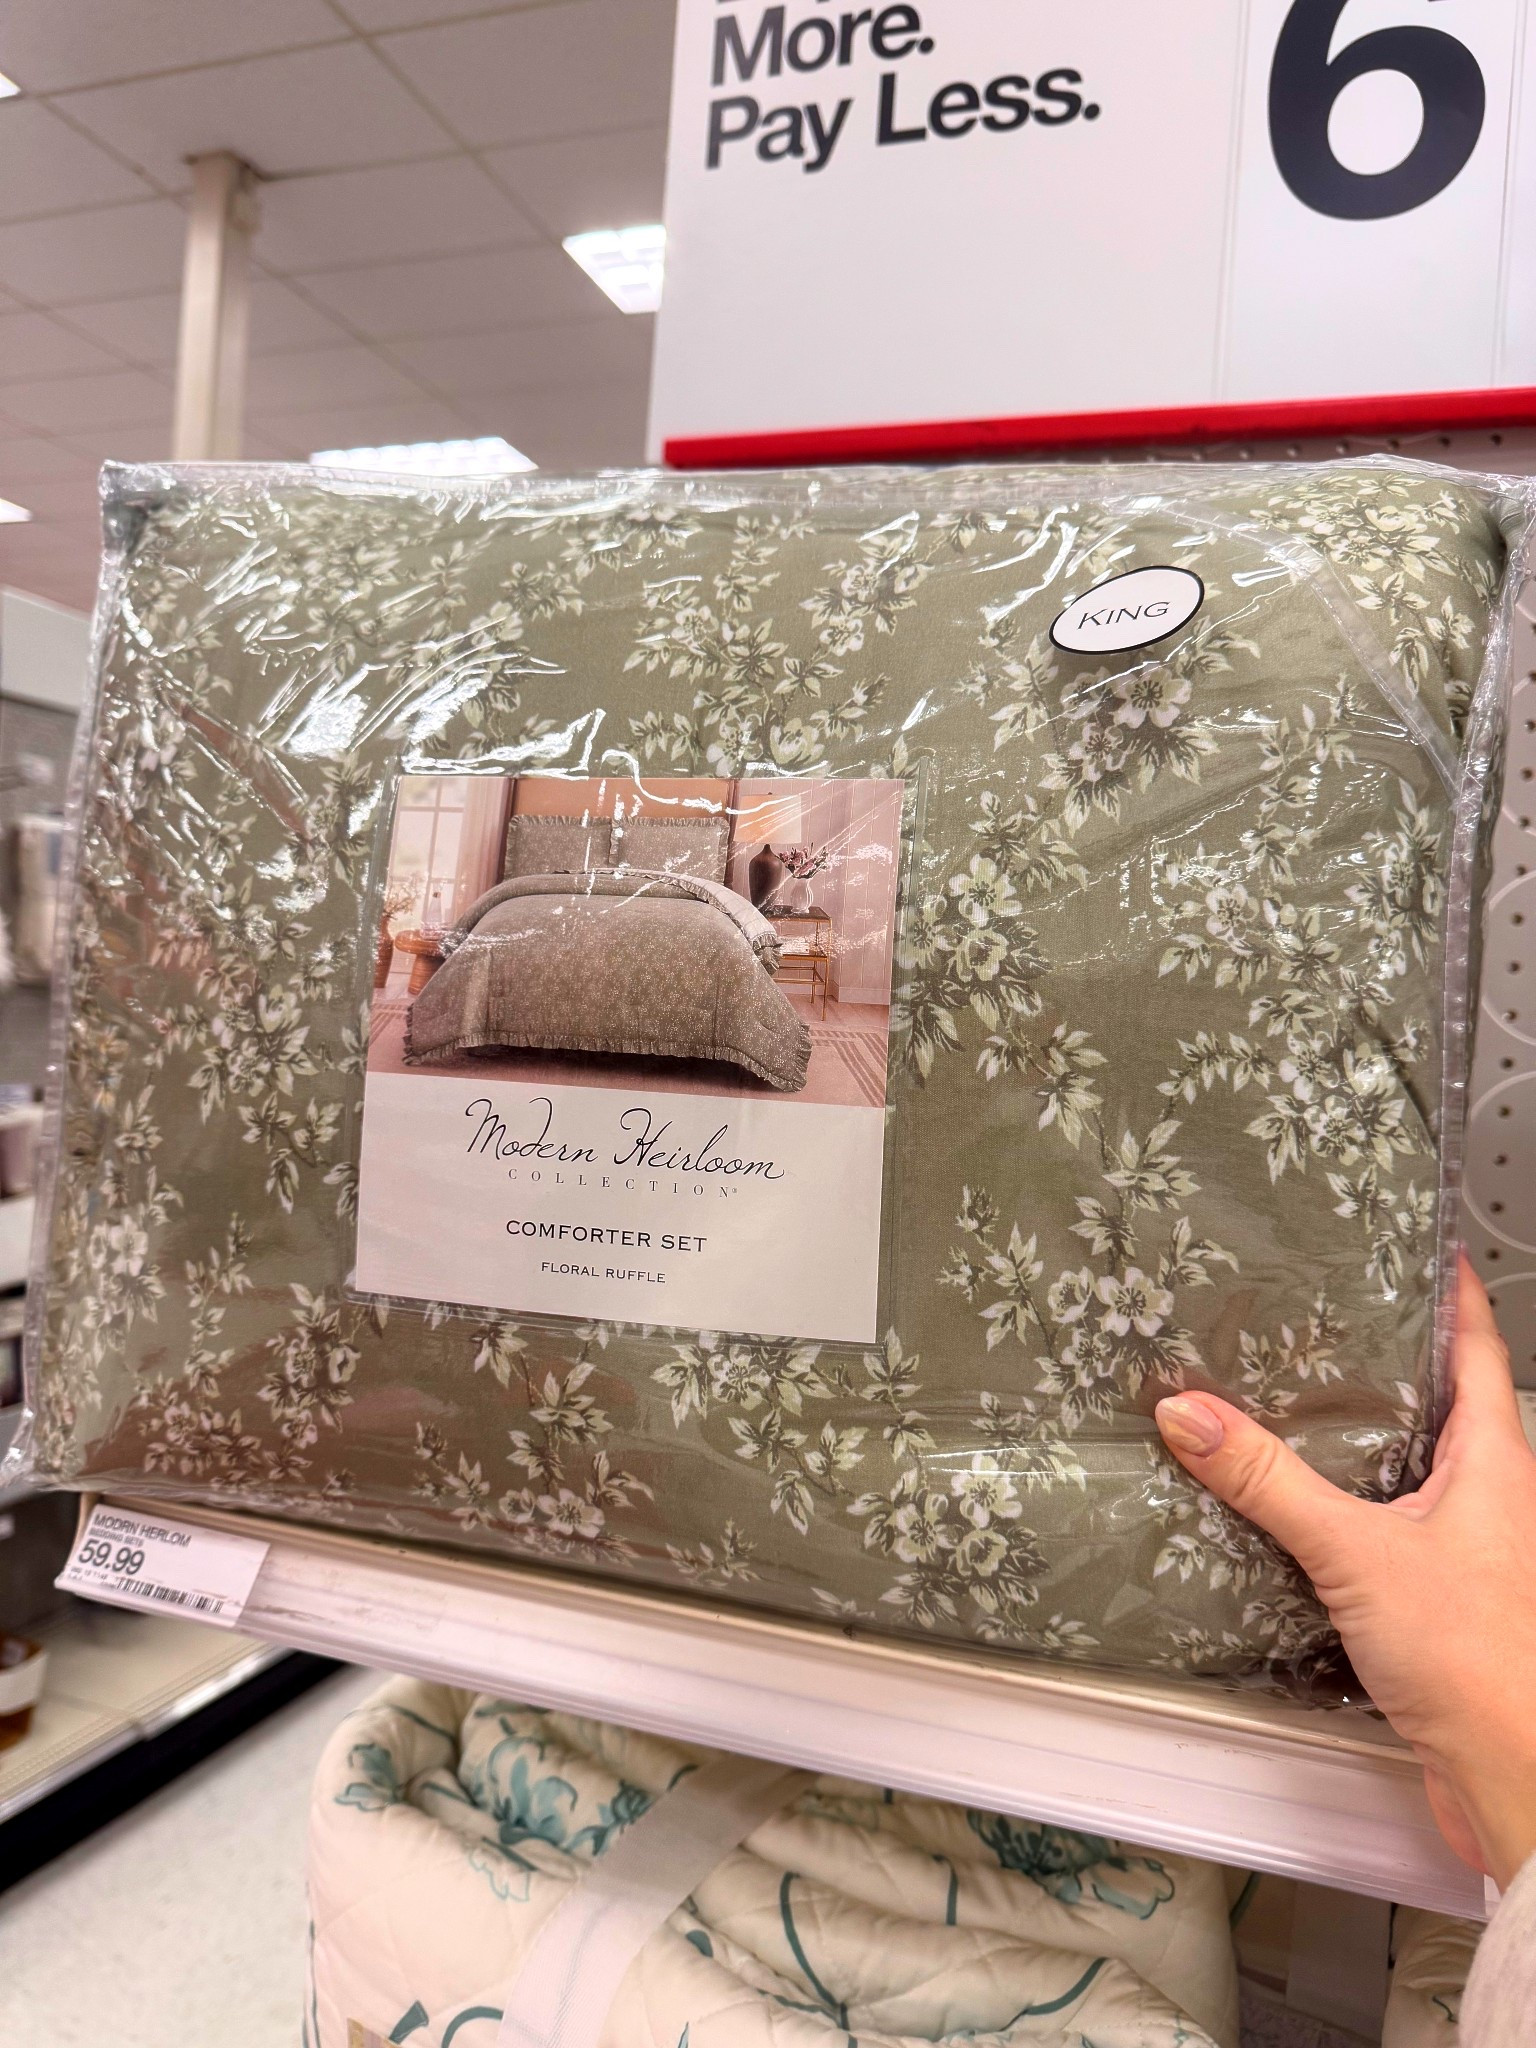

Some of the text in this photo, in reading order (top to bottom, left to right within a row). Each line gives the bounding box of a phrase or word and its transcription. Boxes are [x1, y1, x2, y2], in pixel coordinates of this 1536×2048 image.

[711, 3, 935, 88] More.
[705, 66, 1101, 173] Pay Less.
[1267, 0, 1485, 221] 6
[1077, 601, 1171, 630] KING
[464, 1097, 785, 1180] Modern Heirloom
[506, 1219, 708, 1253] COMFORTER SET
[541, 1261, 666, 1284] FLORAL RUFFLE
[94, 1514, 140, 1534] MODRN
[78, 1539, 145, 1575] 59.99
